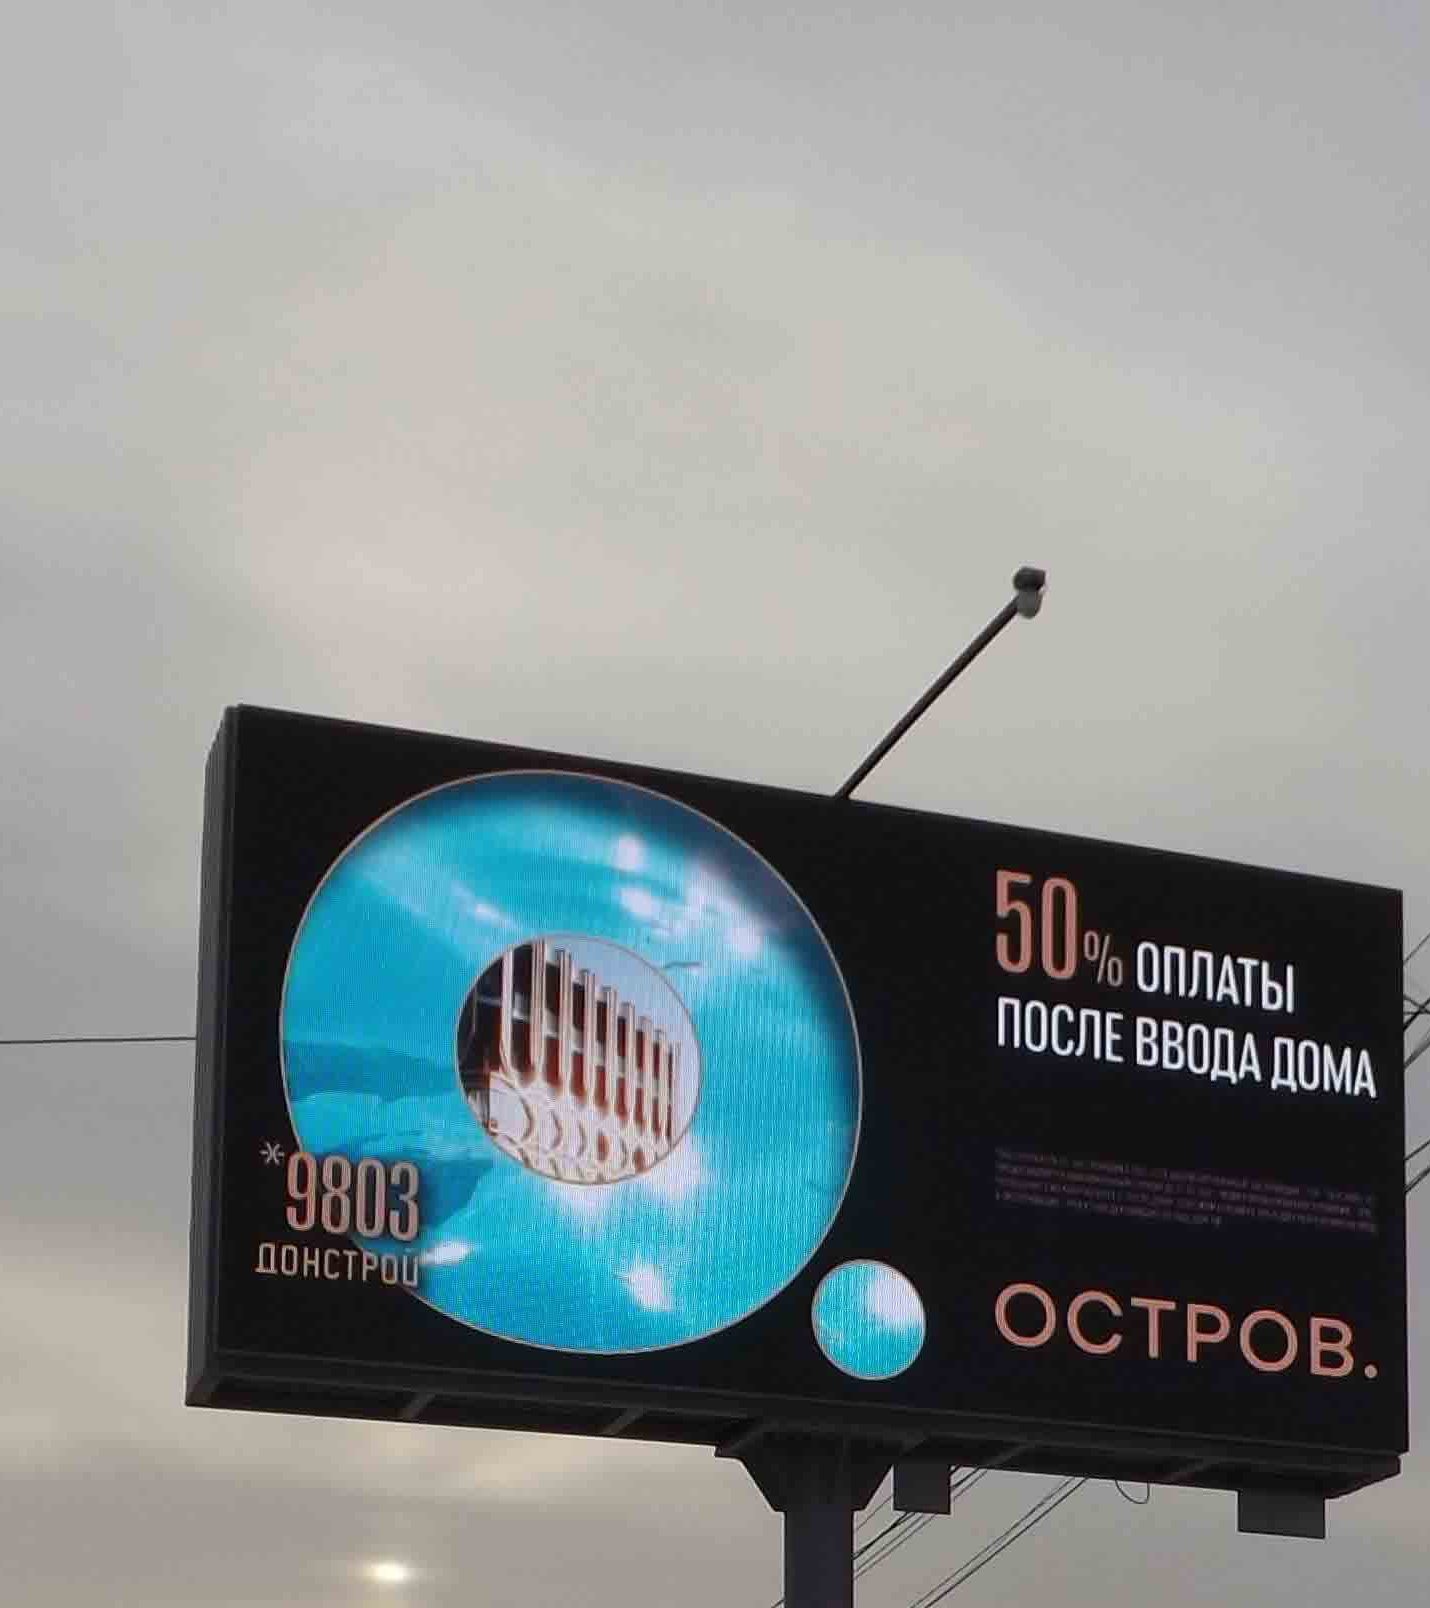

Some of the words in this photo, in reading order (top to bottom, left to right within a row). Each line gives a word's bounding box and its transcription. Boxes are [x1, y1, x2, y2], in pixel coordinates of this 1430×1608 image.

[995, 869, 1124, 988] 50%
[1137, 941, 1295, 1013] ОПЛАТЫ
[997, 996, 1125, 1063] ПОСЛЕ
[1135, 1016, 1263, 1084] ВВОДА
[1271, 1036, 1377, 1099] ДОМА
[994, 1283, 1379, 1380] ОСТРОВ.
